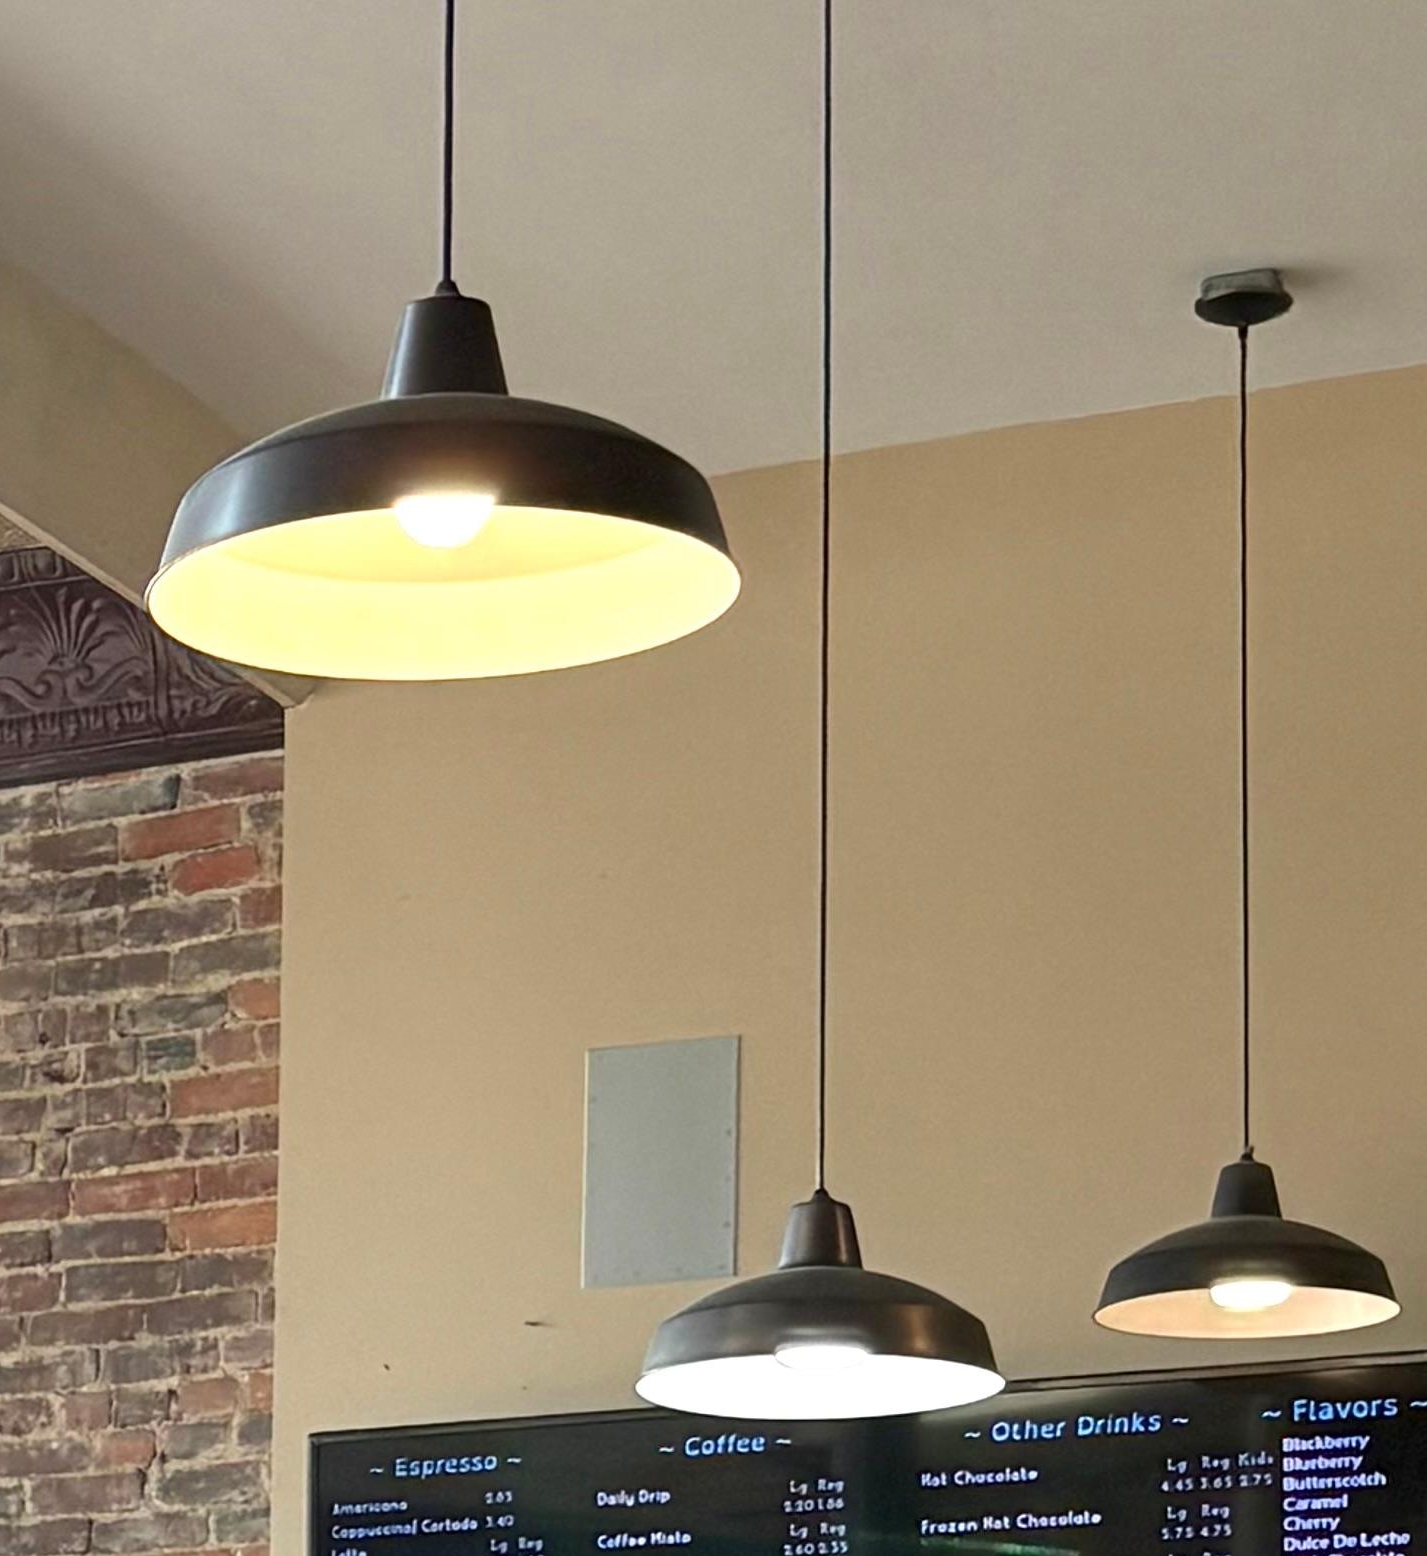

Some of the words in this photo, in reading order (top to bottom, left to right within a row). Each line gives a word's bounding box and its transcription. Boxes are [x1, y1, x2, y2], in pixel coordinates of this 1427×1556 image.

[1293, 1399, 1398, 1421] Flavors
[991, 1421, 1066, 1442] Other
[1078, 1413, 1162, 1435] Drinks
[685, 1433, 766, 1457] Coffee
[395, 1455, 498, 1480] Espresso
[597, 1491, 634, 1507] Daily
[638, 1489, 670, 1504] Drip
[921, 1520, 978, 1535] Frozen
[597, 1534, 646, 1549] Coffee
[1283, 1536, 1330, 1551] Dulce
